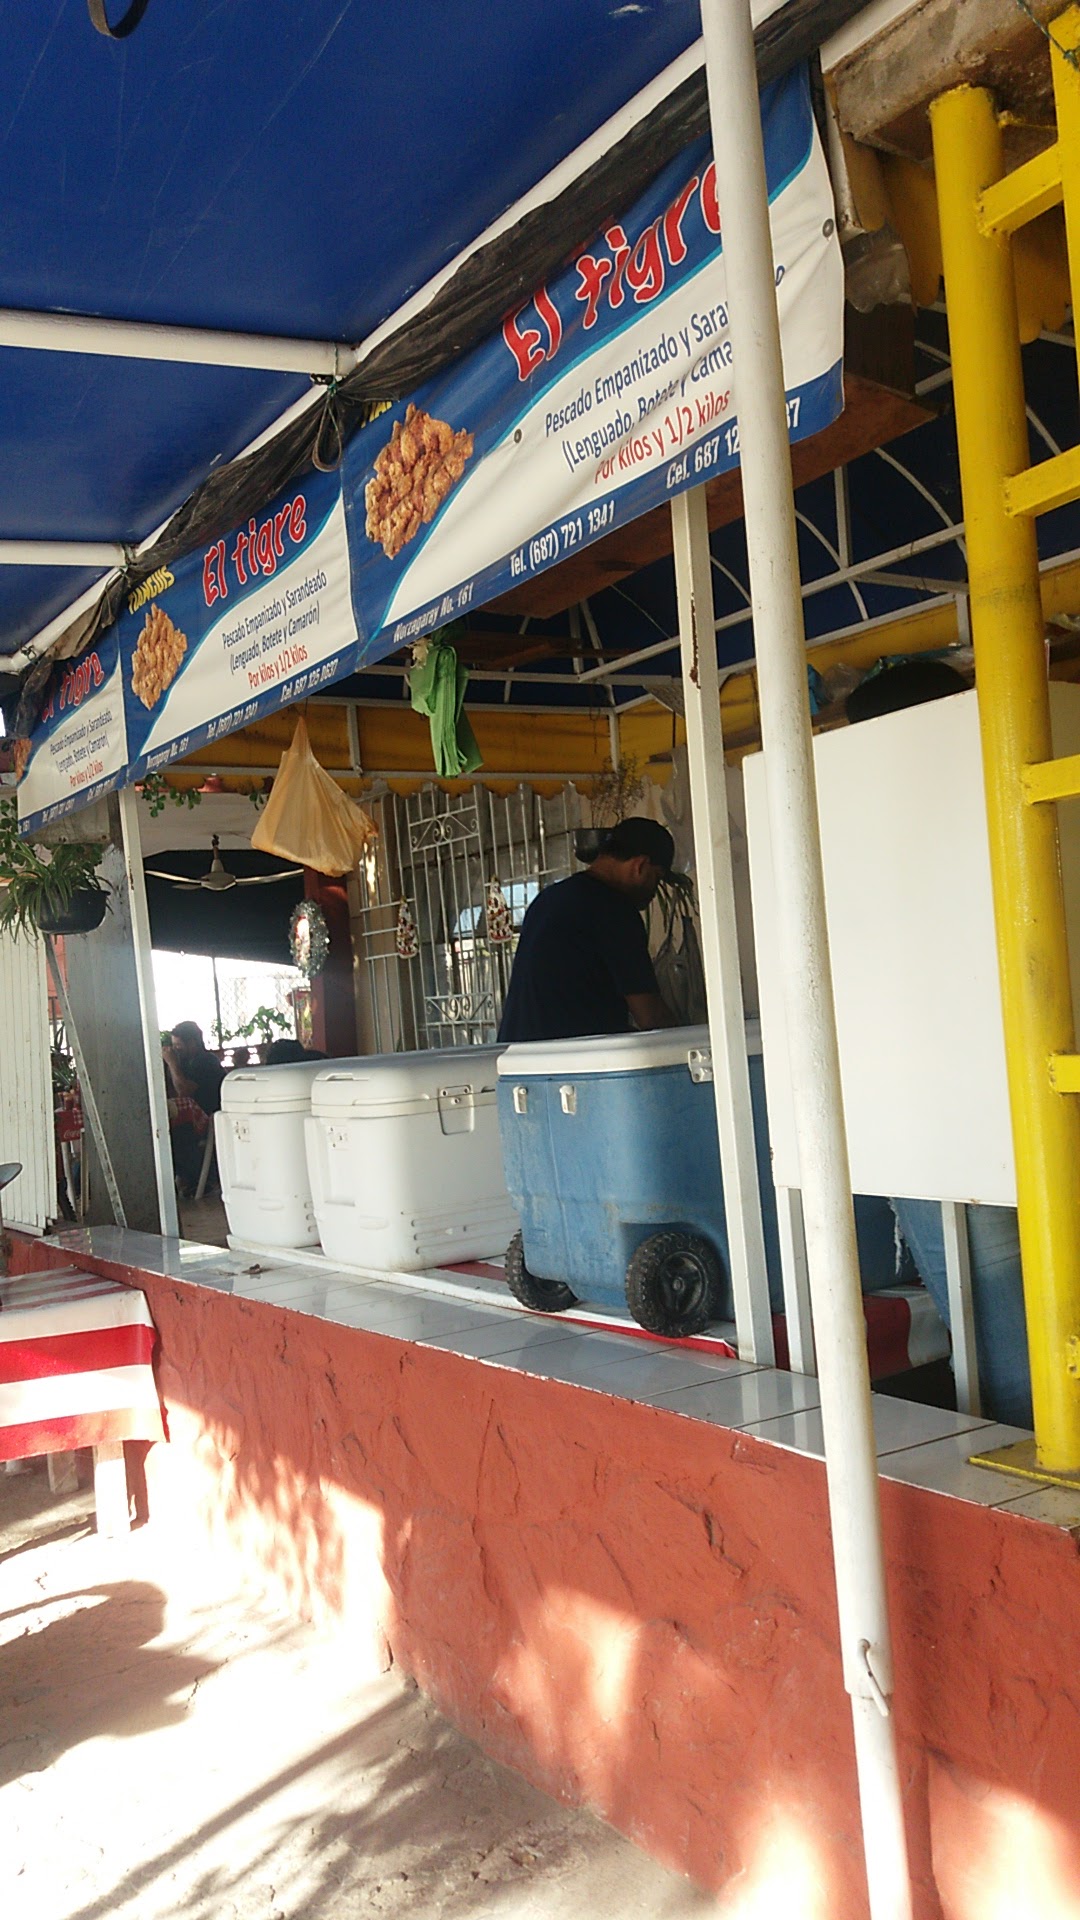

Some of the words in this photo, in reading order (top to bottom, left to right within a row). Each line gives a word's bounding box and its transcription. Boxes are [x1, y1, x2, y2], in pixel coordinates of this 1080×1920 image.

[503, 281, 562, 381] El
[545, 386, 593, 438] Pescado
[595, 333, 679, 399] Empanizado
[679, 327, 691, 357] y
[562, 408, 635, 473] (Lenguado,
[638, 377, 681, 422] Botete
[618, 435, 653, 471] kilos
[652, 428, 665, 458] y
[665, 405, 695, 446] 1/2
[695, 390, 731, 428] kilos
[666, 454, 691, 489] Cel.
[694, 435, 720, 473] 687
[724, 425, 741, 456] 12
[203, 540, 228, 607] El
[231, 494, 307, 584] tigre
[510, 549, 527, 578] Tel.
[529, 528, 560, 571] (687)
[561, 517, 583, 549] 721
[588, 500, 615, 535] 1341
[128, 564, 175, 615] TIANGUIS
[222, 621, 246, 649] Pescado
[244, 598, 281, 634] Empanizado
[280, 597, 287, 616] y
[285, 569, 327, 609] Sarandeado
[457, 581, 474, 607] 161
[247, 671, 260, 690] Por
[258, 661, 275, 684] kilos
[273, 660, 280, 680] y
[278, 649, 292, 675] 1/2
[289, 643, 308, 666] kilos
[261, 627, 283, 653] Botete
[282, 626, 288, 645] y
